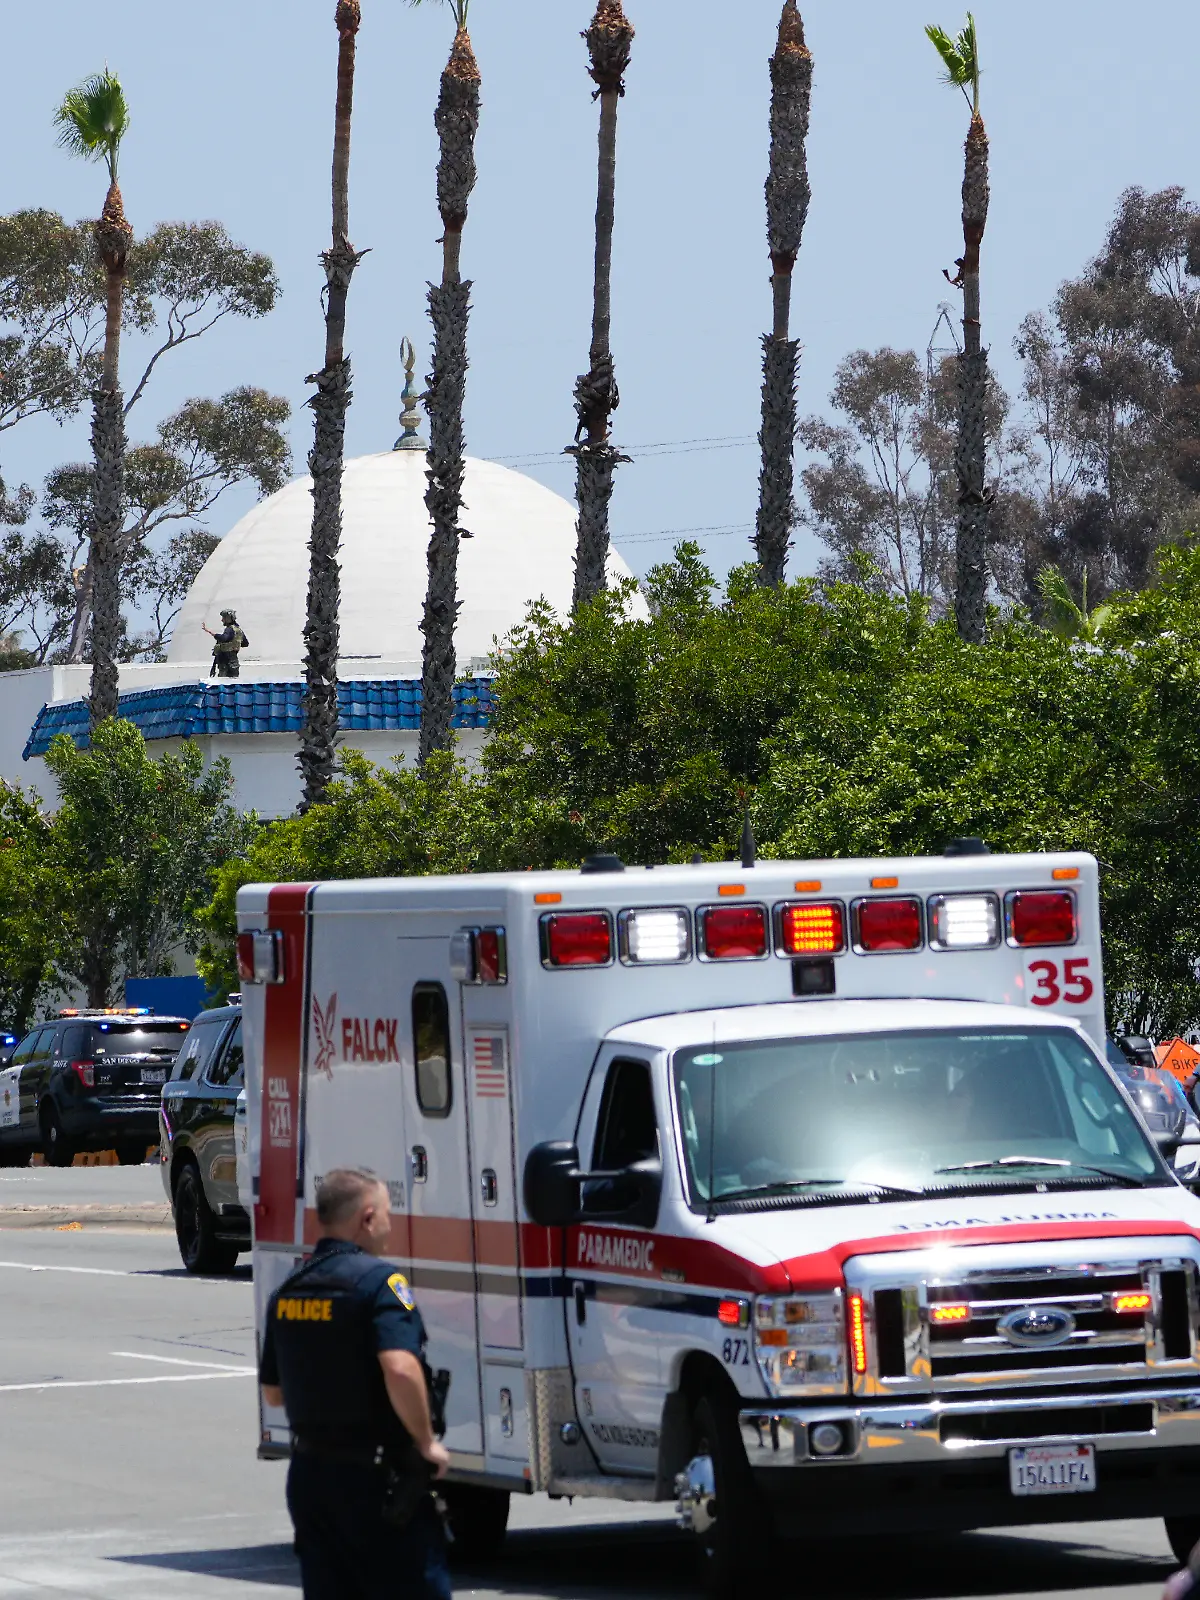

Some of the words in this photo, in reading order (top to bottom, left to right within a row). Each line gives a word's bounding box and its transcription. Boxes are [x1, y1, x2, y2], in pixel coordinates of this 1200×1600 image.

[1027, 957, 1094, 1007] 35
[341, 1017, 400, 1063] FALCK
[101, 1057, 116, 1066] SAN
[117, 1056, 140, 1065] DIEGO
[577, 1232, 656, 1271] PARAMEDIC
[275, 1298, 333, 1321] POLICE
[722, 1337, 750, 1366] 872
[1017, 1462, 1089, 1488] 15411F4
